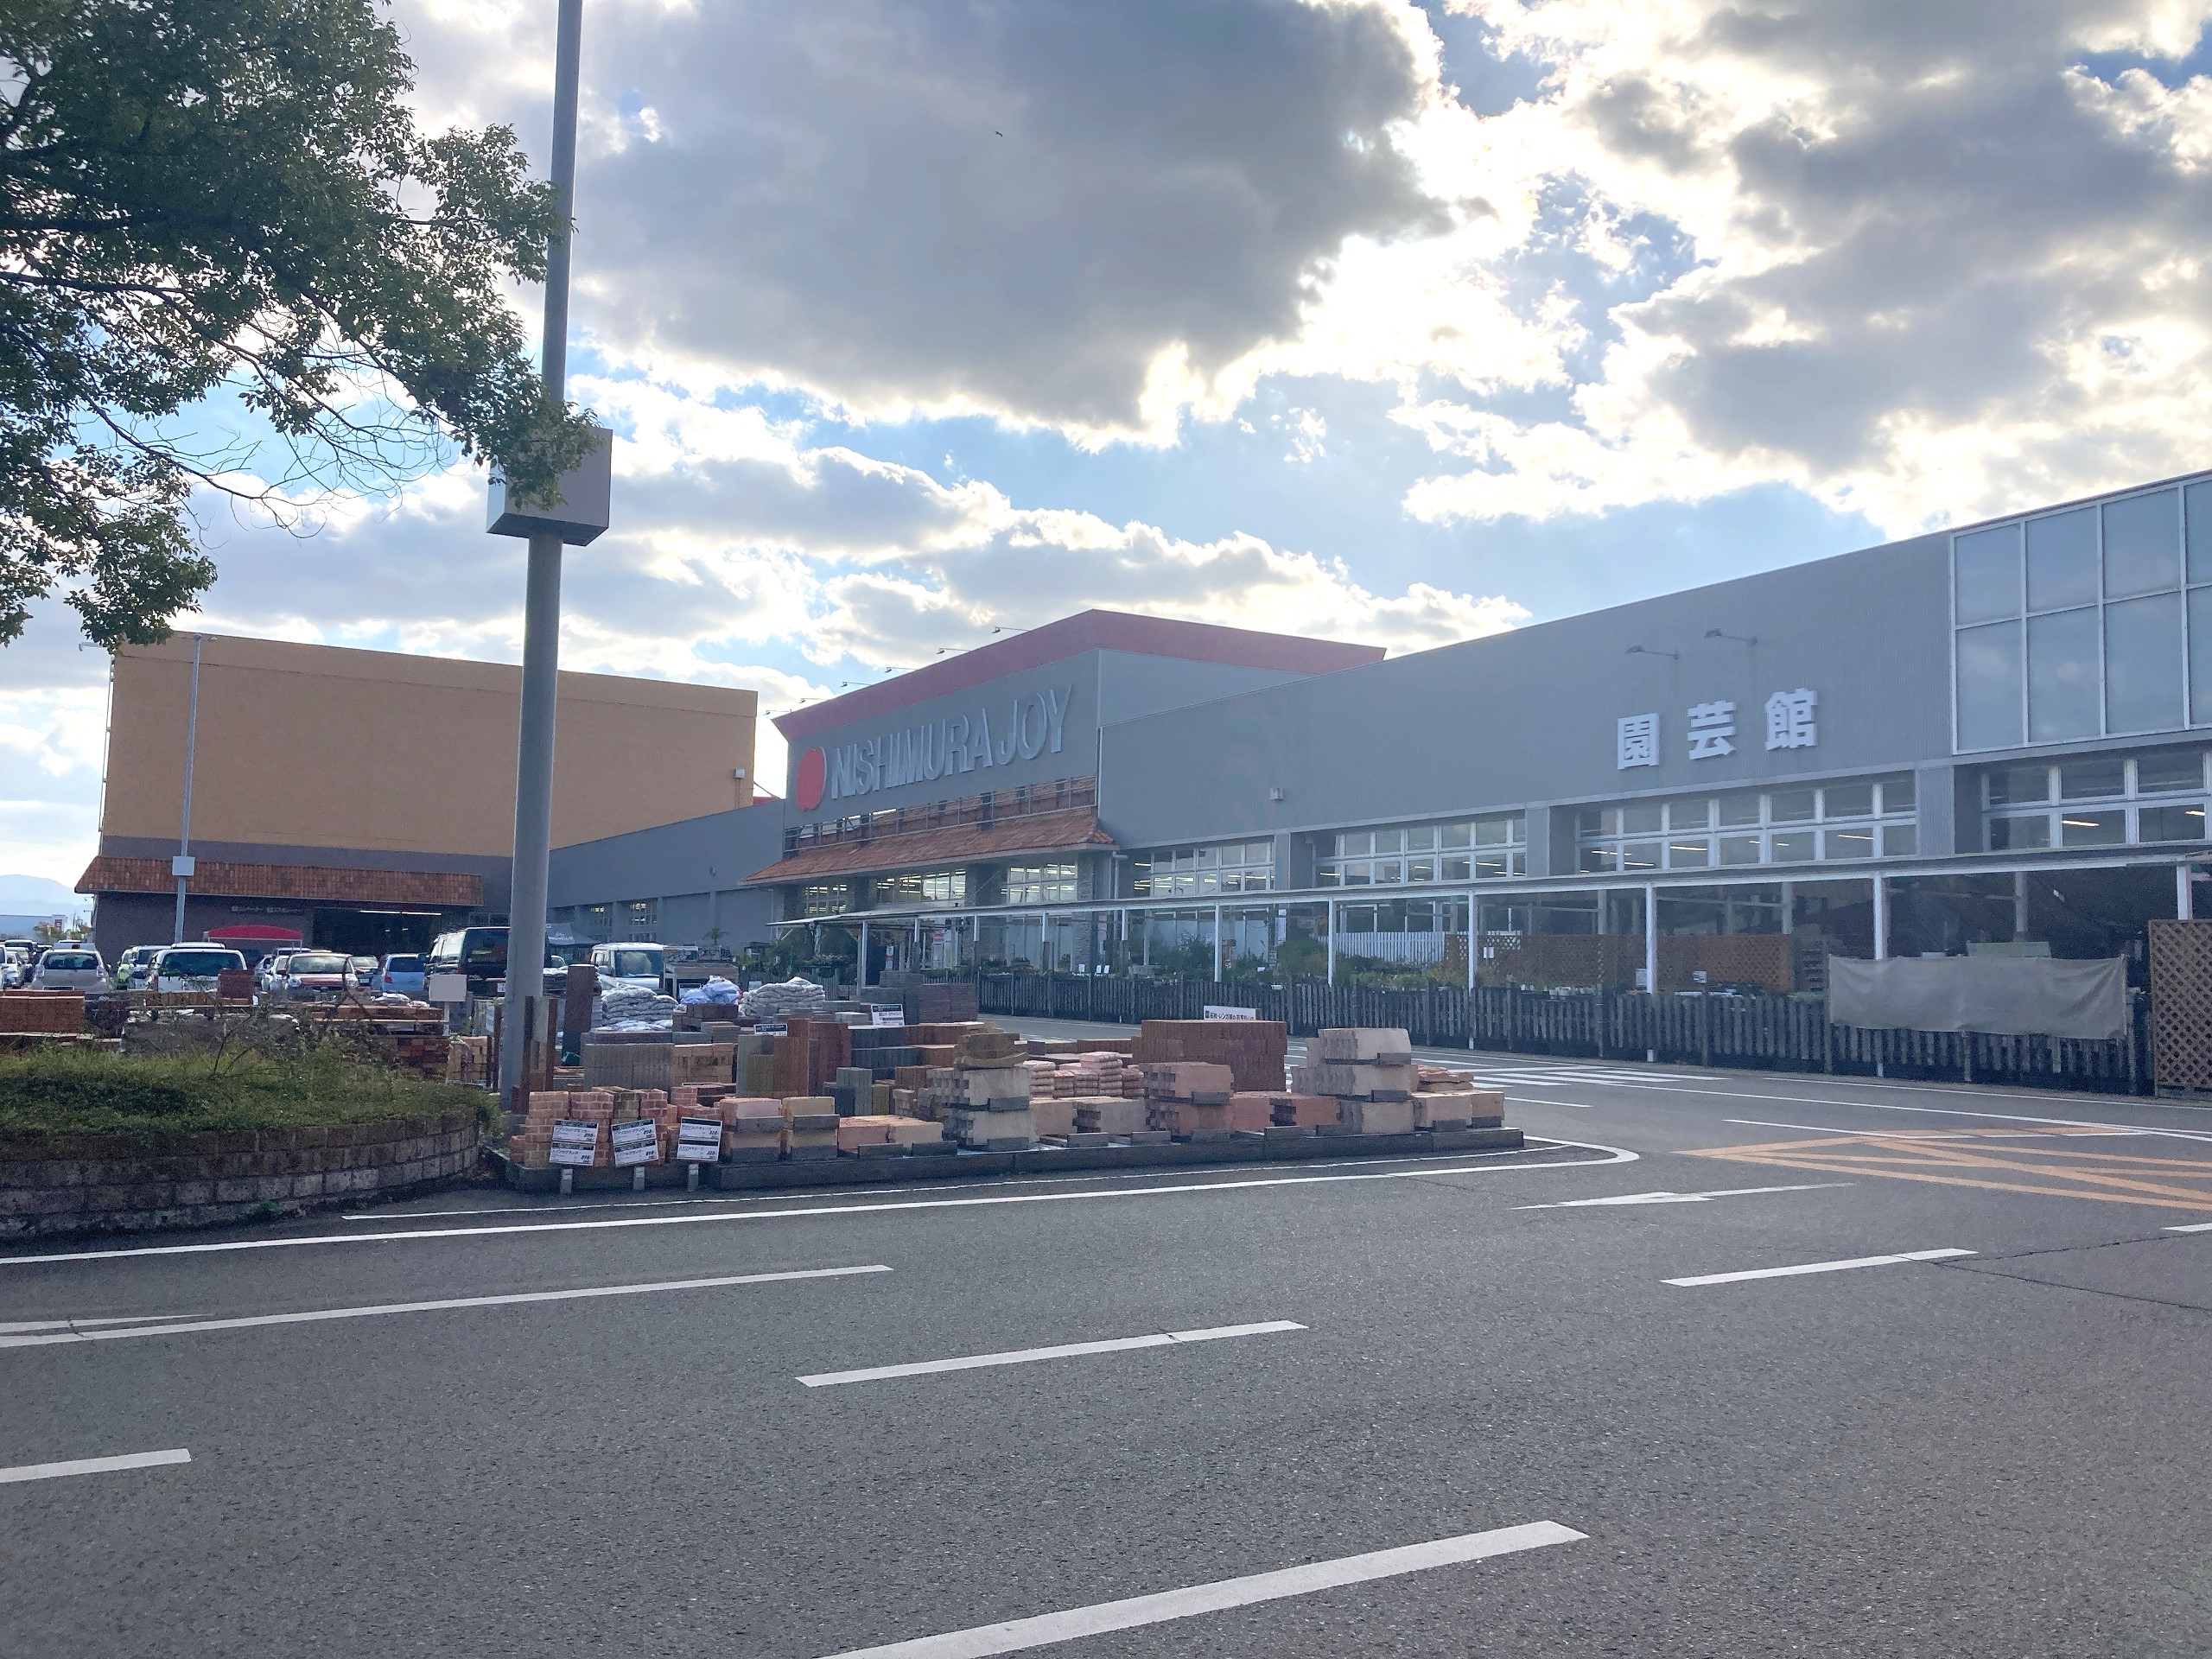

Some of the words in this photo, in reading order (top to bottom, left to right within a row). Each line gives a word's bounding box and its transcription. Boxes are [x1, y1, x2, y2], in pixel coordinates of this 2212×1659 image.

[831, 708, 993, 800] NISHIMURA
[995, 683, 1074, 766] JOY
[1618, 688, 1818, 770] 園芸館
